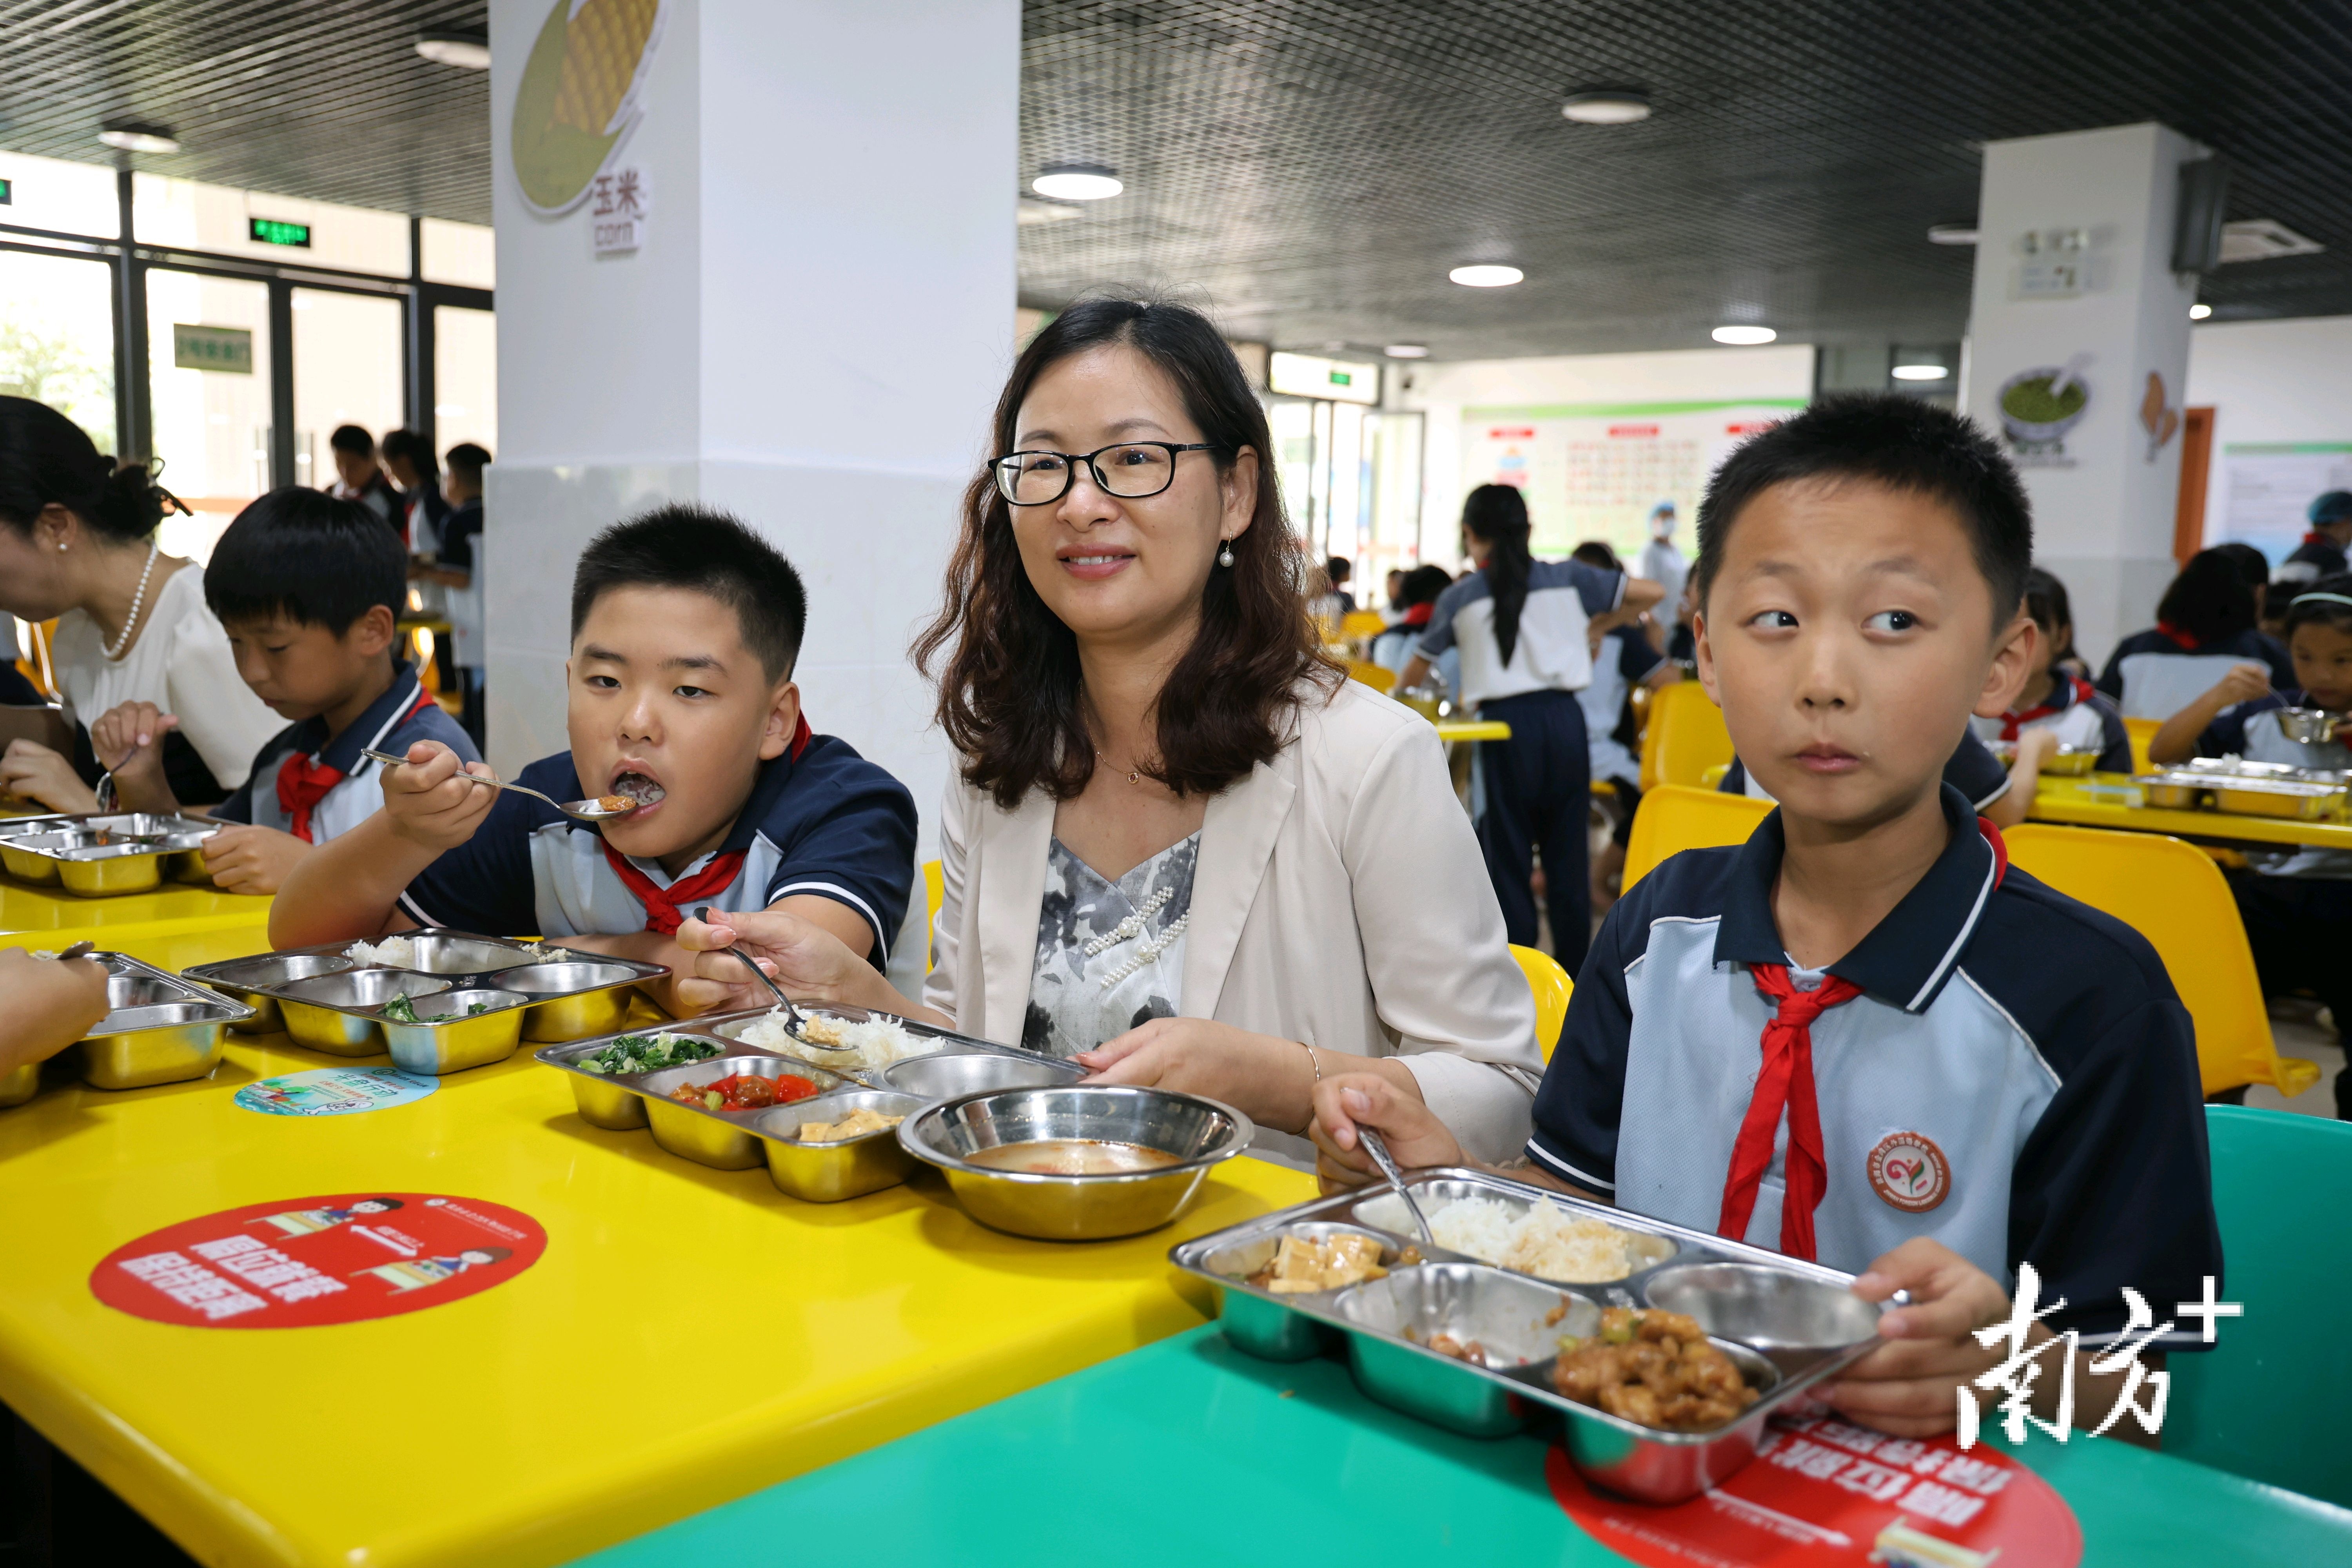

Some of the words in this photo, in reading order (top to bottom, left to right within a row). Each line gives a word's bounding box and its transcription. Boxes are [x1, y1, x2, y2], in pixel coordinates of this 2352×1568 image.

[593, 169, 639, 216] 玉米
[595, 222, 633, 246] corn
[327, 1074, 399, 1097] 光盘行动
[118, 1251, 269, 1320] 保持距离
[189, 1234, 348, 1303] 隔位就餐
